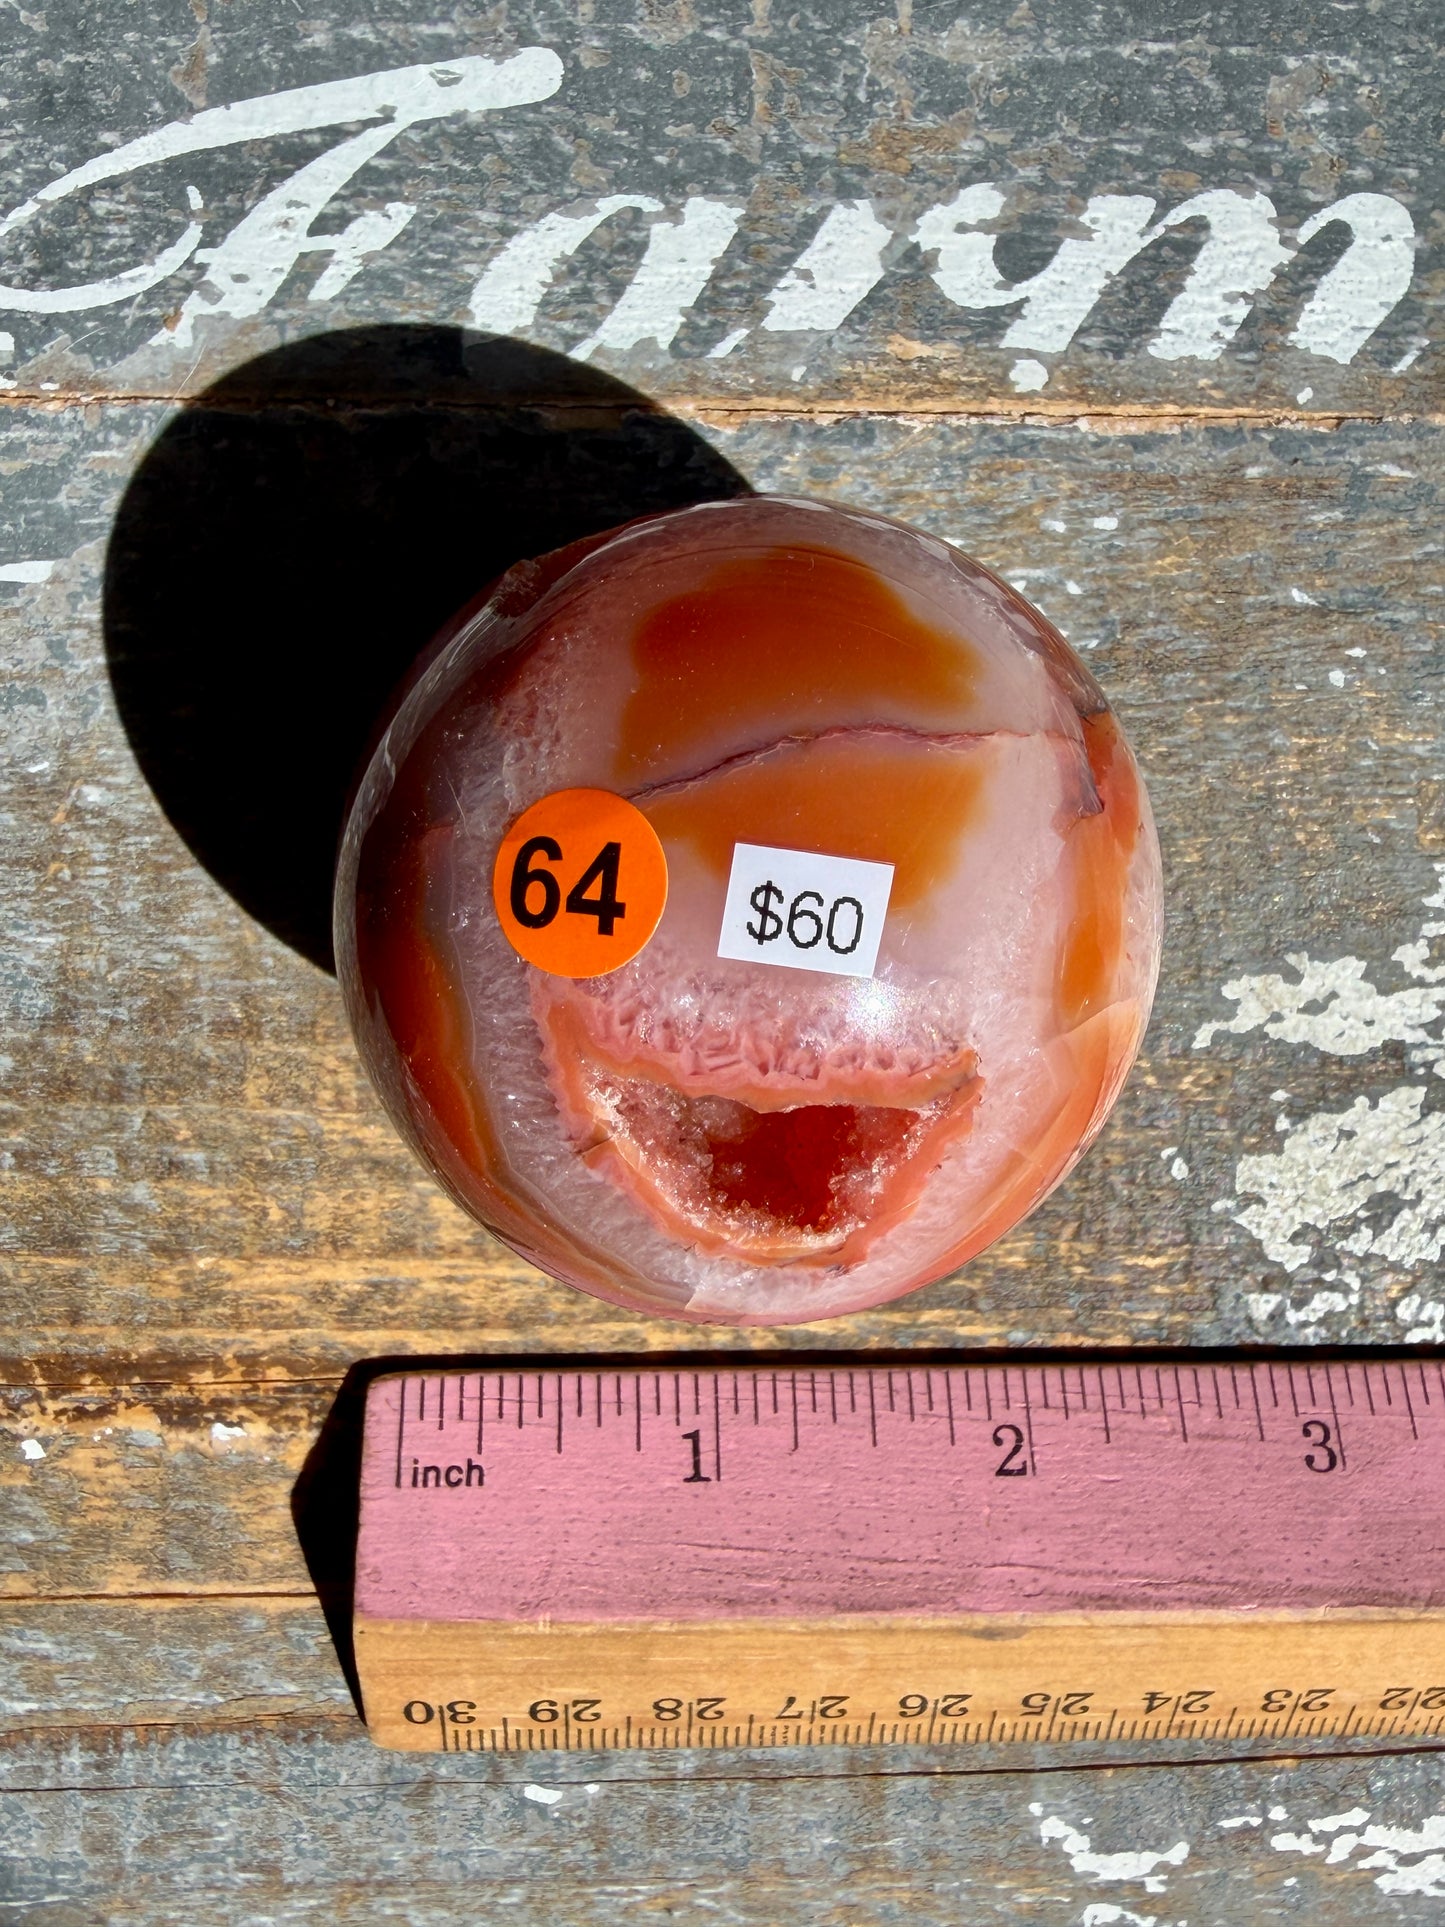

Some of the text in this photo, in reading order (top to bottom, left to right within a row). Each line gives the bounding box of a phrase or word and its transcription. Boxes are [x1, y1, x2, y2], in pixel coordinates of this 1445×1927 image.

[0, 46, 1425, 368] Farm
[508, 834, 627, 937] 64
[746, 879, 864, 955] $60
[682, 1420, 1338, 1483] 1 2 3
[411, 1458, 485, 1488] inch
[403, 1699, 477, 1725] 30
[528, 1699, 603, 1724] 29
[653, 1697, 727, 1721] 28
[775, 1695, 850, 1720] 27
[899, 1694, 973, 1718] 26
[1020, 1692, 1094, 1717] 25
[1142, 1690, 1215, 1715] 24
[1261, 1688, 1336, 1713] 23
